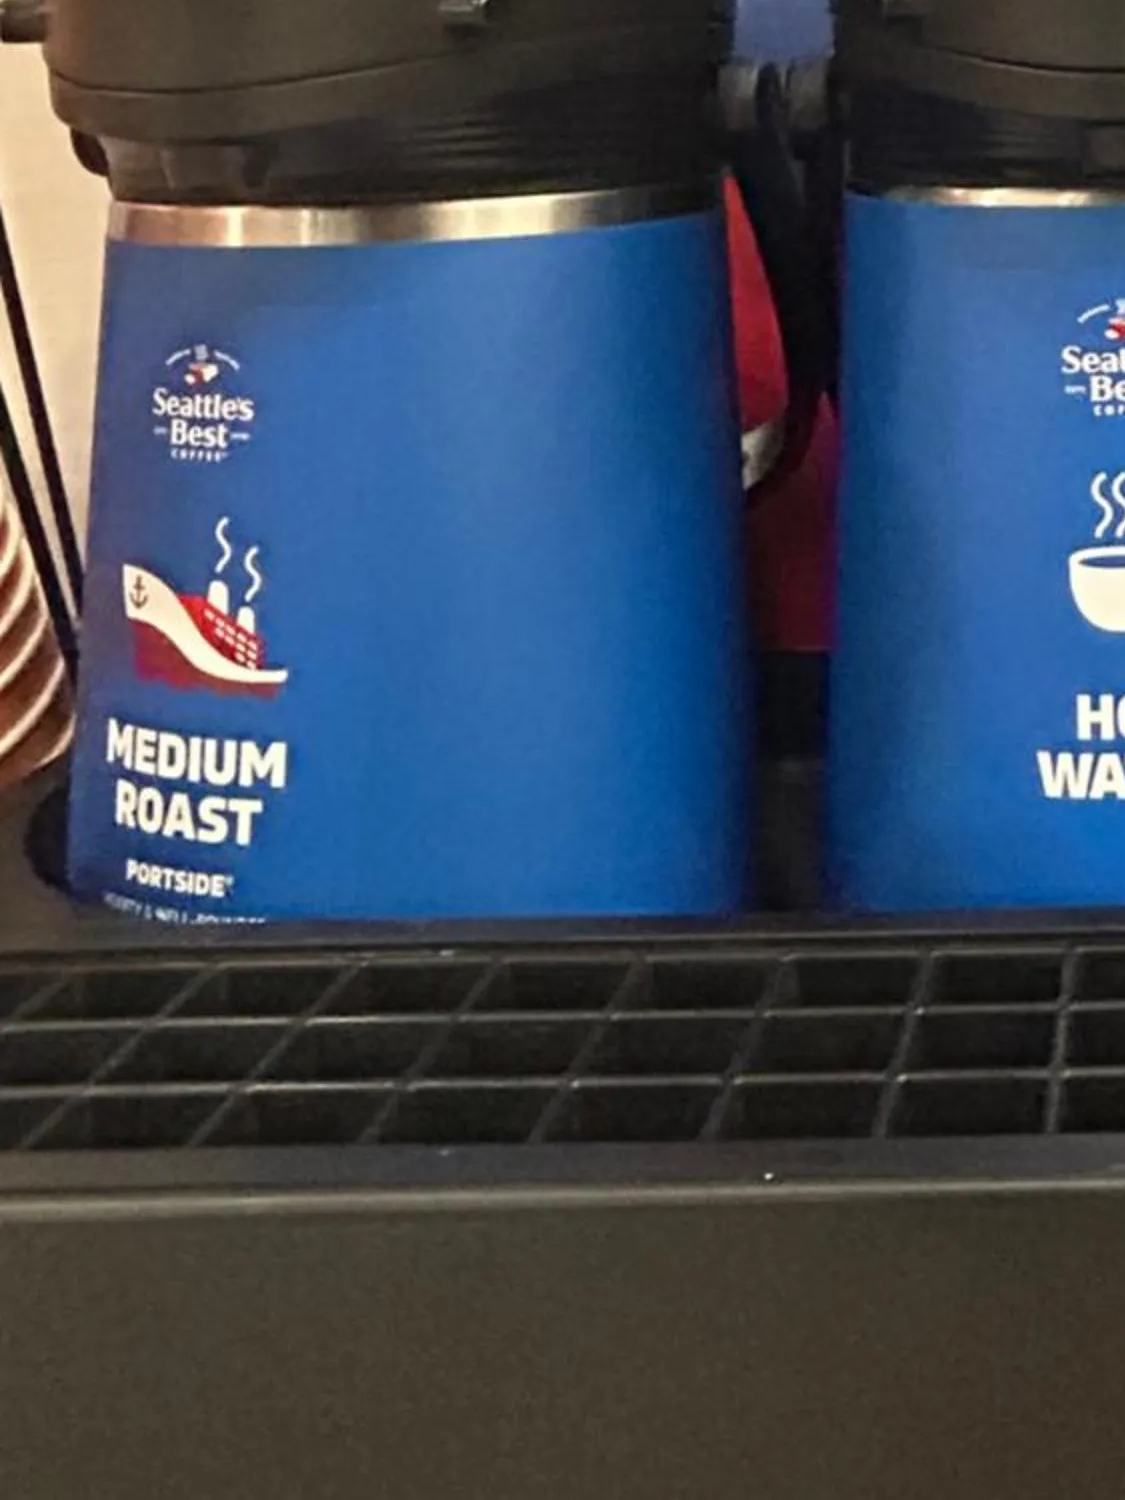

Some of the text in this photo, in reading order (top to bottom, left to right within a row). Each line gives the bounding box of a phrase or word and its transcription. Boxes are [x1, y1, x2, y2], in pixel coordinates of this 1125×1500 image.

[152, 386, 255, 421] Seattle's
[170, 418, 229, 449] Best
[105, 717, 288, 790] MEDIUM
[113, 778, 264, 848] ROAST
